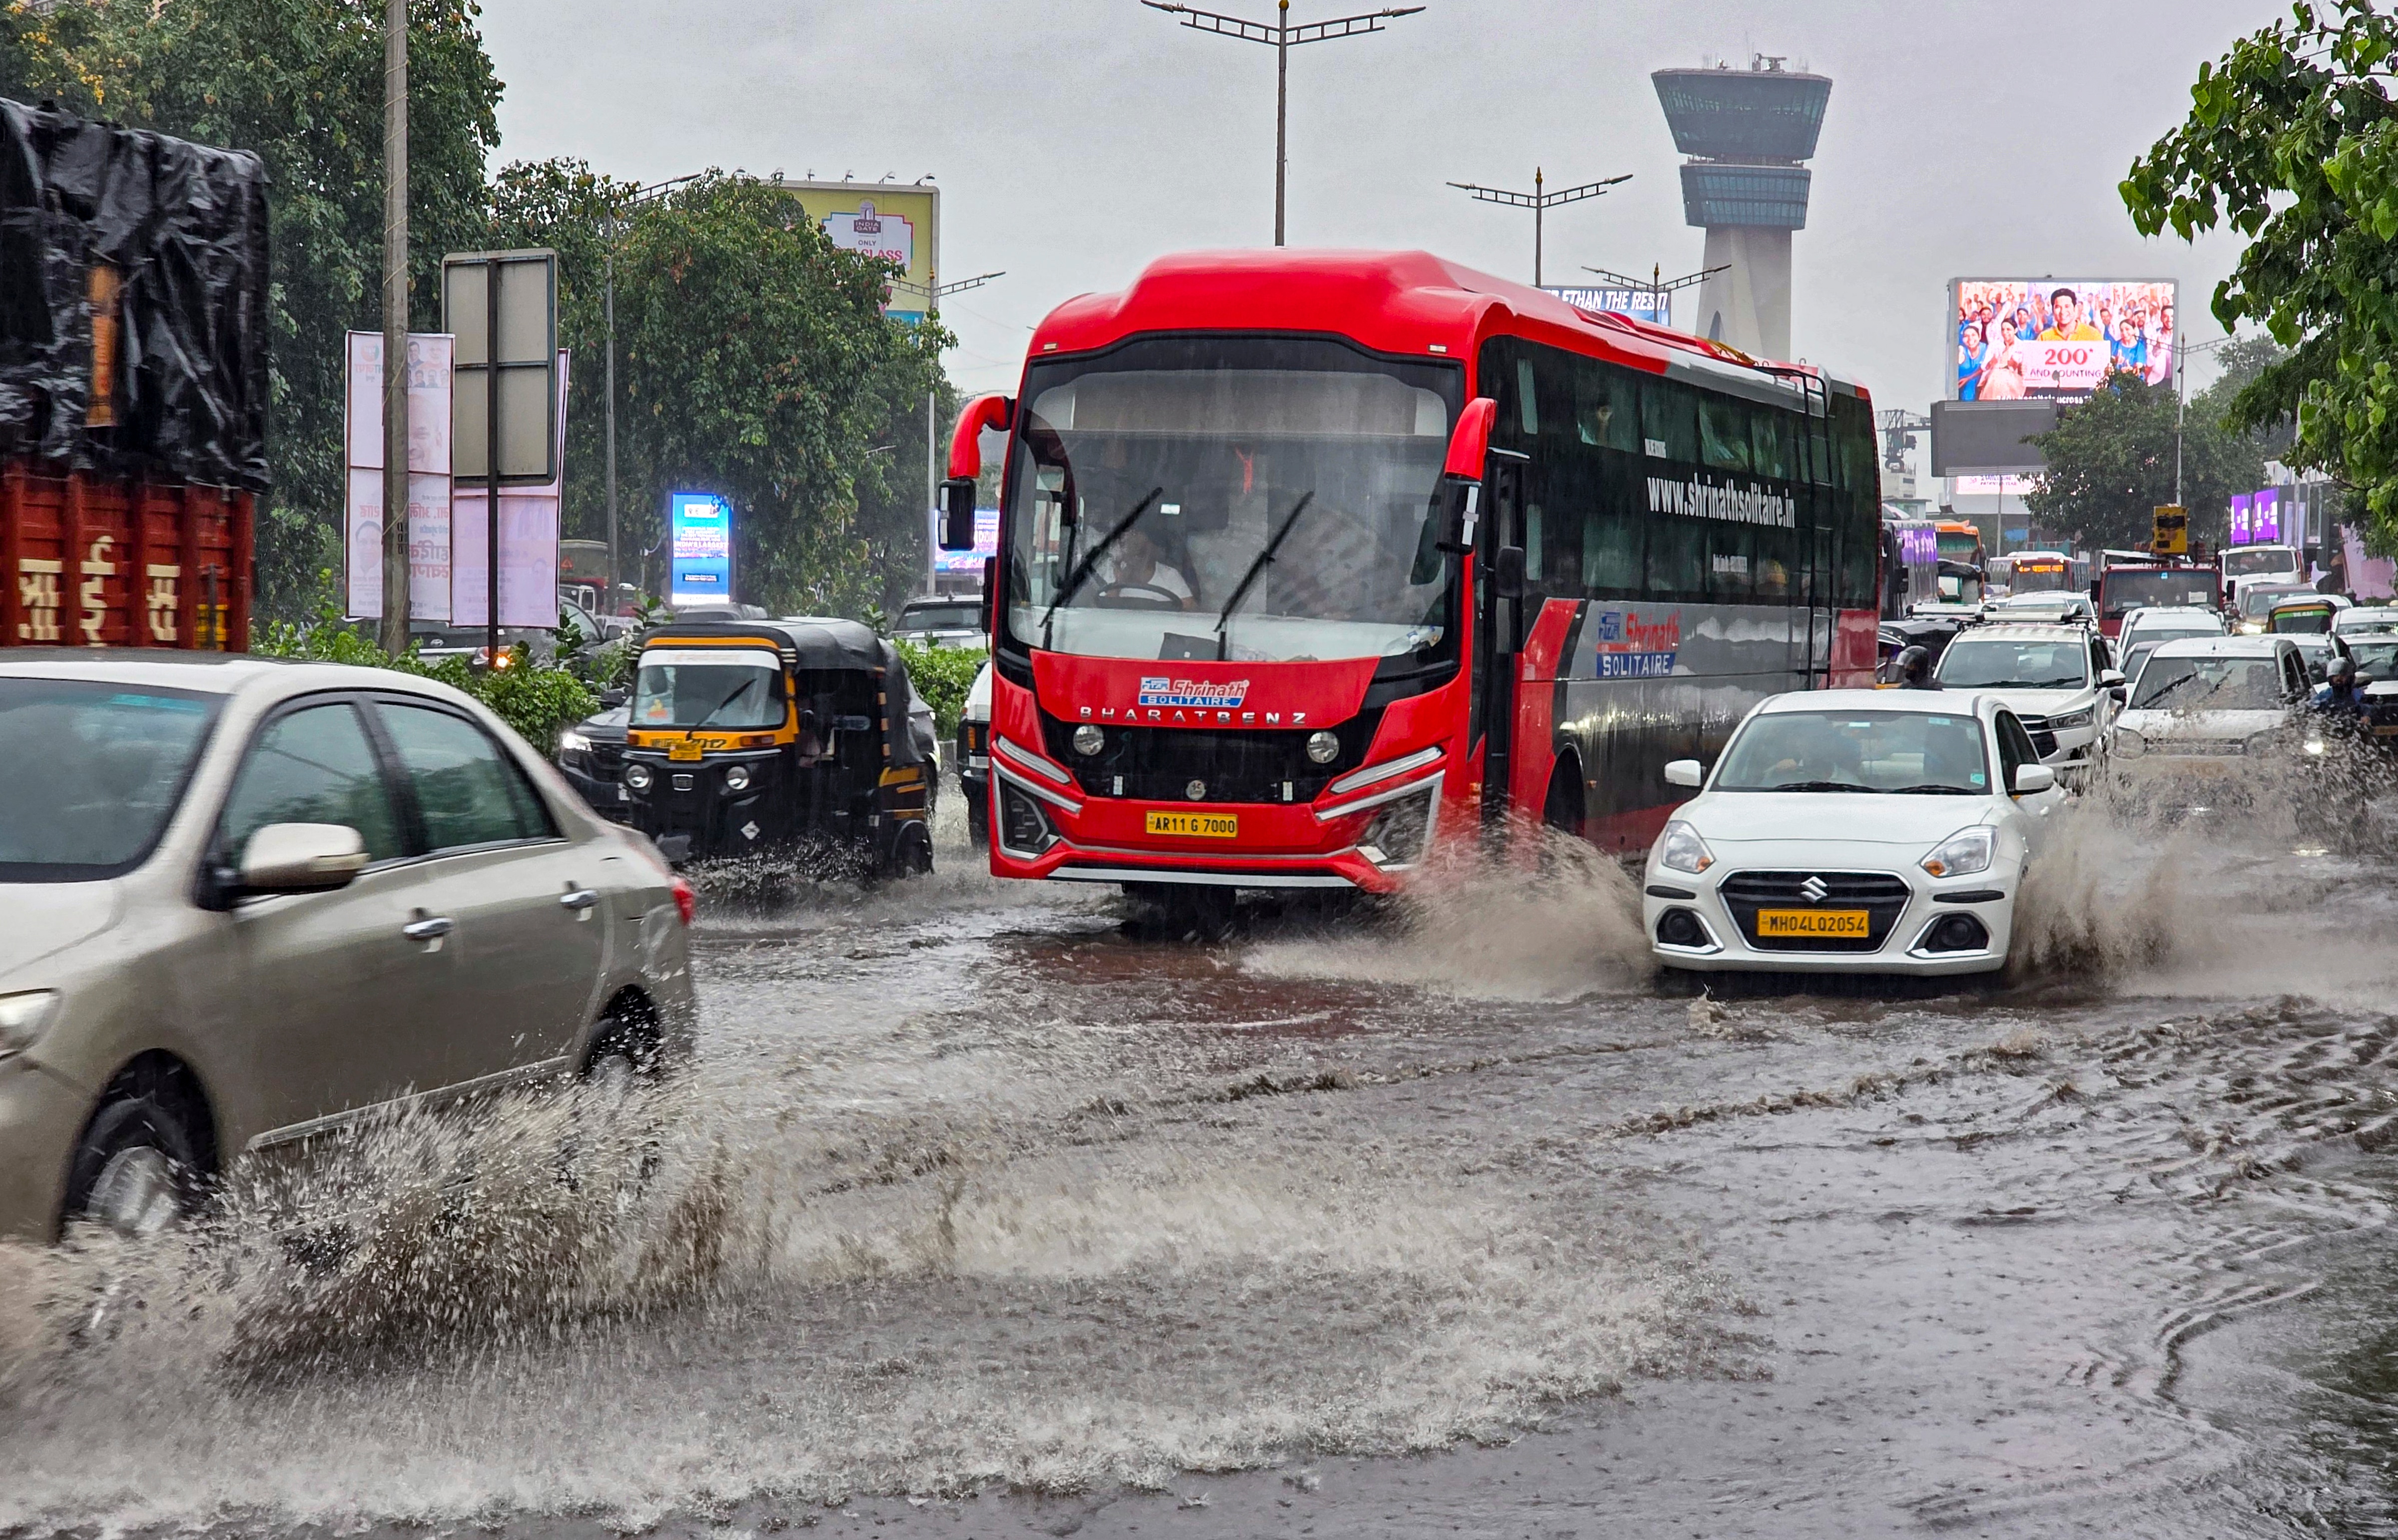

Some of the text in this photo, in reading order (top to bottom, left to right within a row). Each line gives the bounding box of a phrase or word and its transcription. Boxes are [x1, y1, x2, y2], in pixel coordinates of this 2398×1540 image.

[1605, 290, 1631, 310] THE
[2030, 368, 2101, 378] AND OUNTING
[1647, 472, 1795, 529] www.shrinathsolitaire.in
[1603, 654, 1671, 676] SOLITAIRE
[1174, 679, 1246, 696] Shrinath
[1148, 696, 1231, 706] SOLITAIRE
[1080, 706, 1306, 724] BHARATBENZ
[1155, 817, 1235, 833] AR11 G 7000
[1770, 916, 1865, 933] MH04LQ2054
